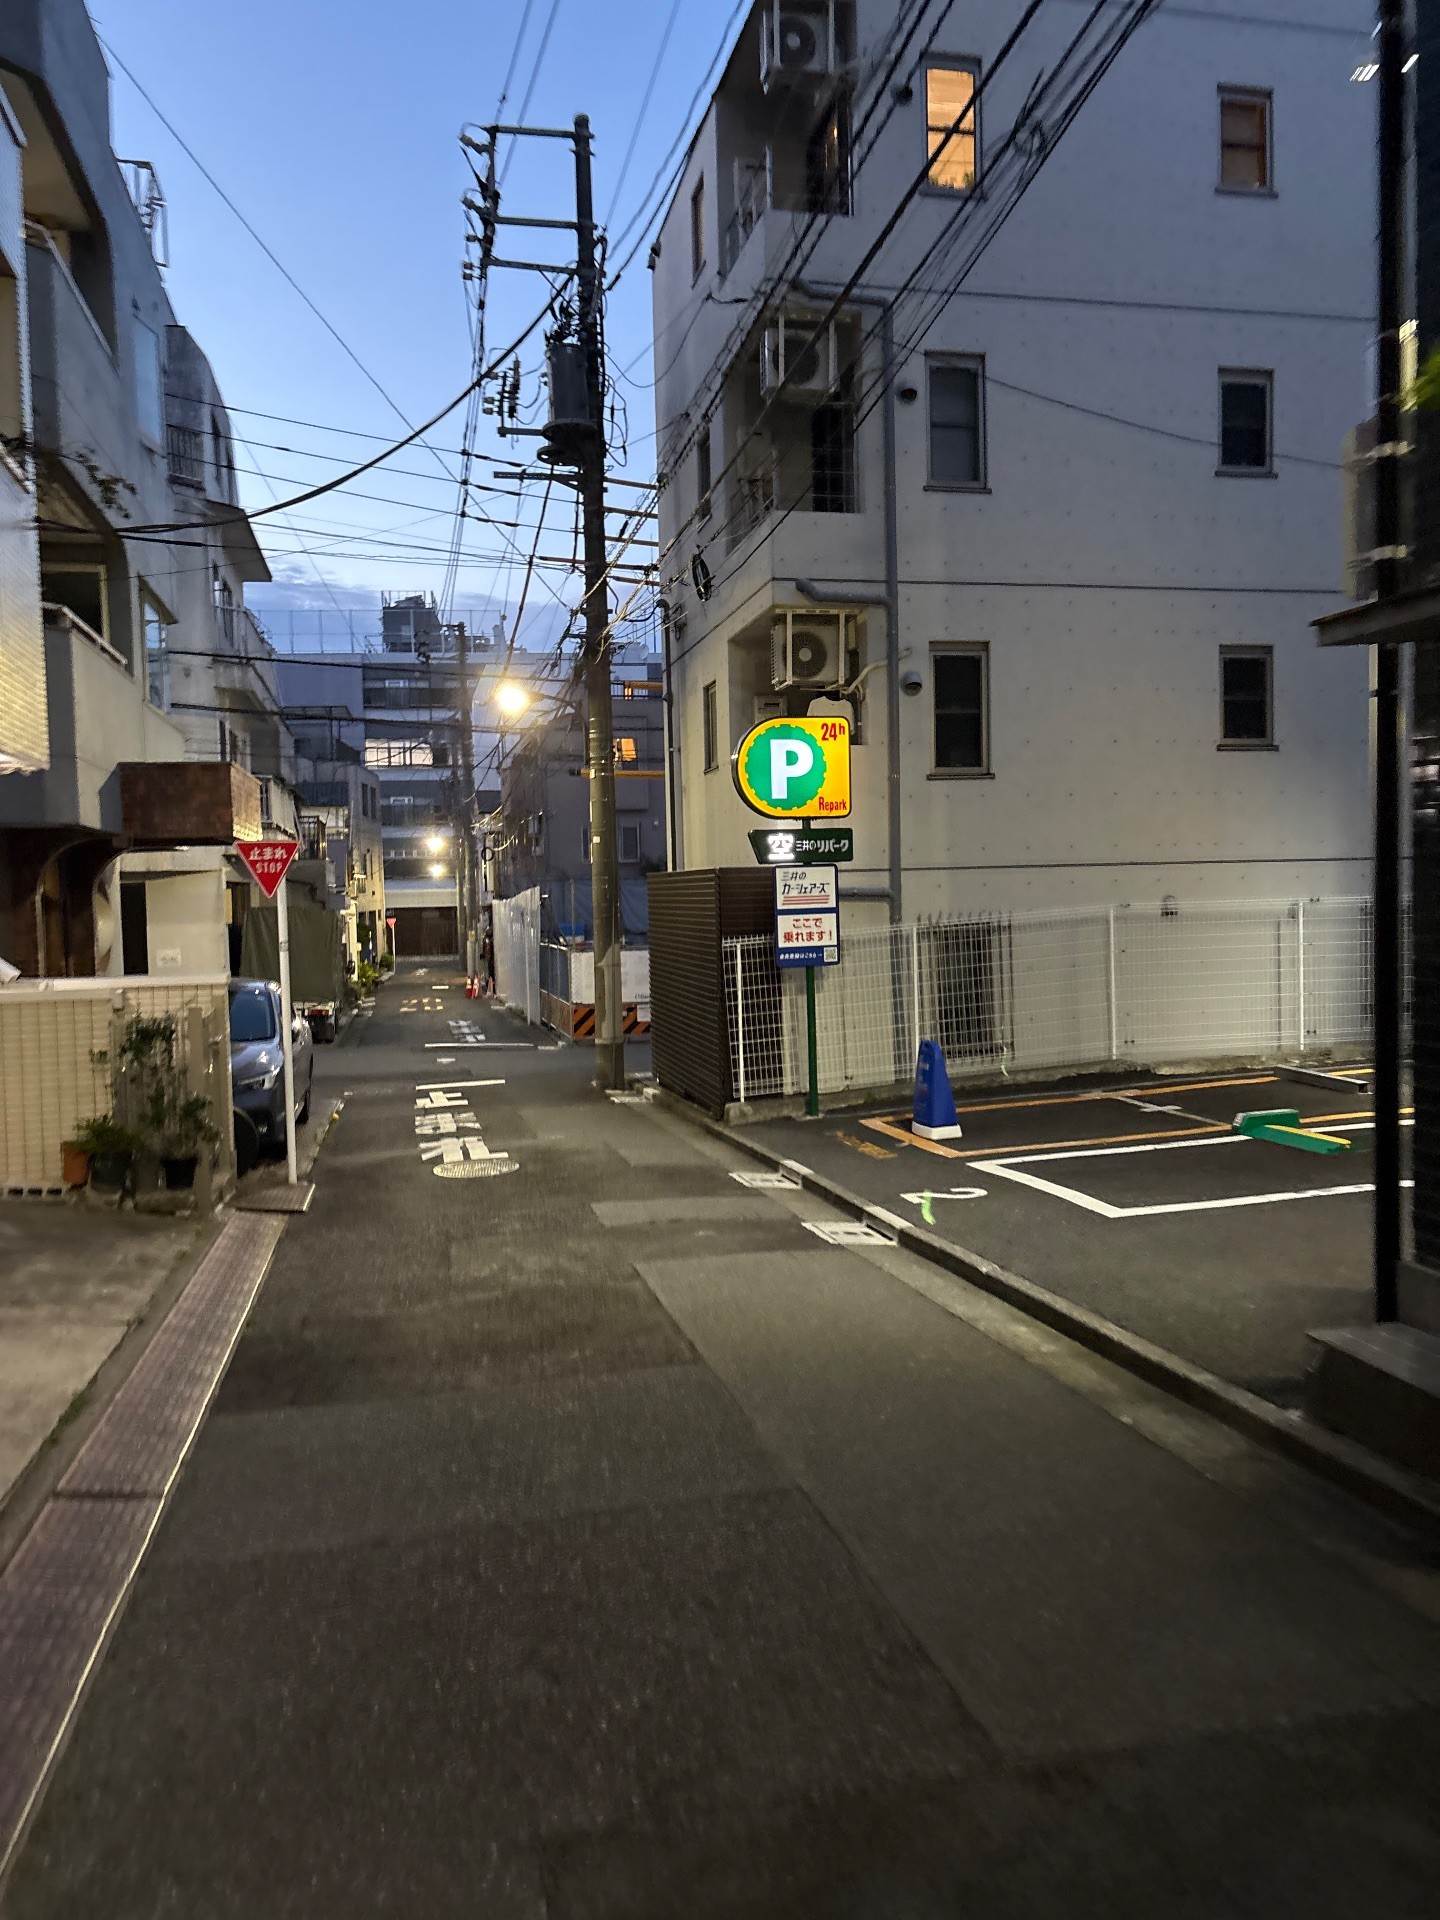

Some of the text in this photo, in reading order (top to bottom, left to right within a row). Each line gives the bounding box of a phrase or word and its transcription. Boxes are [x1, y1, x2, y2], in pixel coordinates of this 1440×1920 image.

[821, 723, 846, 741] 24h
[770, 739, 814, 799] P
[818, 796, 847, 812] Repark
[248, 846, 287, 860] 止まれ
[767, 832, 795, 860] 空
[795, 839, 849, 852] 三井のリパーク
[256, 862, 282, 873] STOP
[781, 871, 806, 881] 三井の
[792, 917, 822, 928] ここで
[413, 1091, 509, 1162] 止まれ
